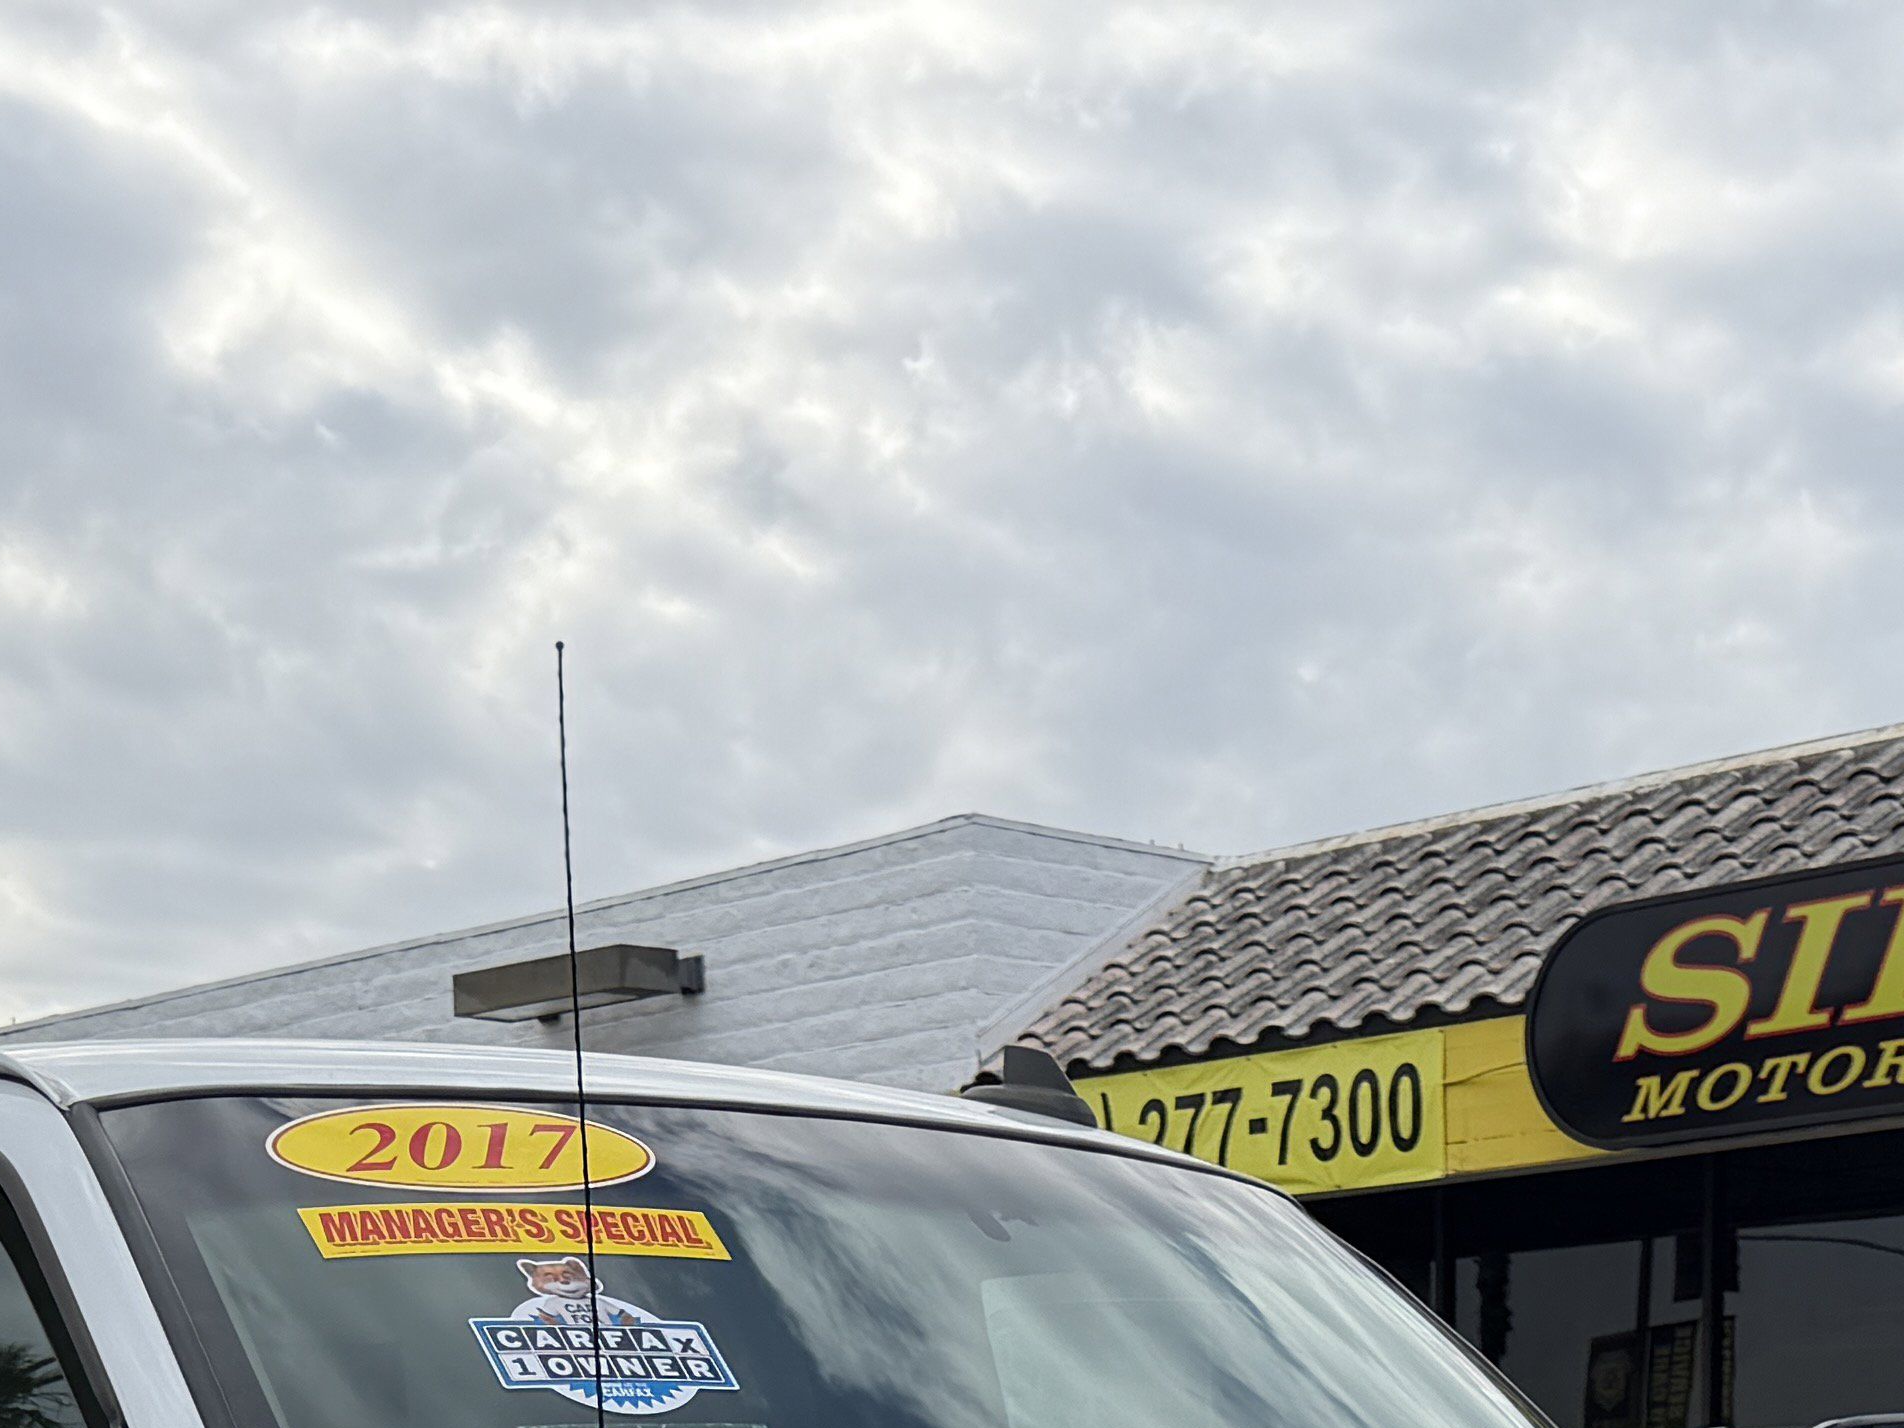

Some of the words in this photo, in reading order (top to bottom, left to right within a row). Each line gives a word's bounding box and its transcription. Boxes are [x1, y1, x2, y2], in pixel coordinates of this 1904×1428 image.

[345, 1120, 579, 1173] 2017
[317, 1207, 555, 1250] MANAGER'S
[555, 1209, 713, 1250] SPECIAL
[495, 1328, 701, 1355] CARFAX
[512, 1357, 538, 1377] 1
[546, 1355, 720, 1380] OWNER
